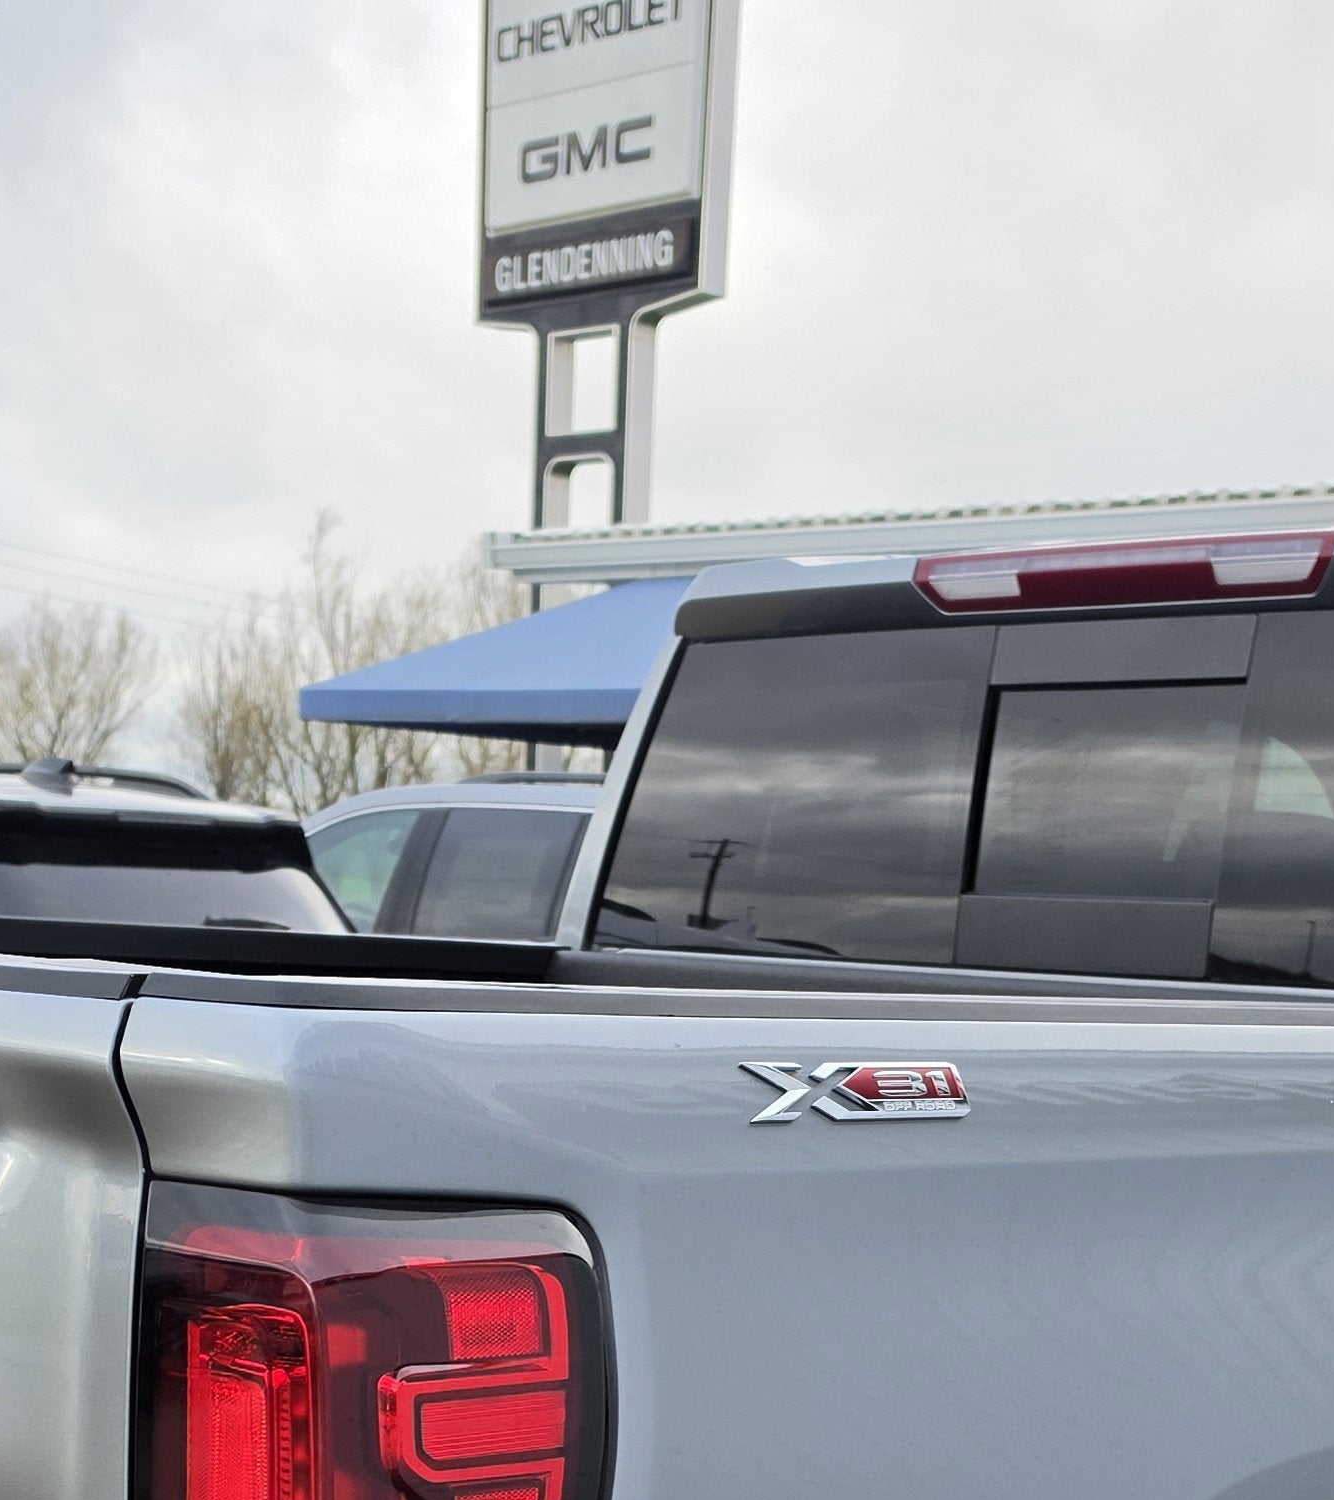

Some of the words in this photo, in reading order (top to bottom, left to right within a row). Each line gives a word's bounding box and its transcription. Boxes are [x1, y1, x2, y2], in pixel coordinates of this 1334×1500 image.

[521, 114, 653, 184] GMC
[494, 229, 675, 292] GLENDENNING
[883, 1101, 912, 1111] OFF
[915, 1100, 956, 1110] ROAD
